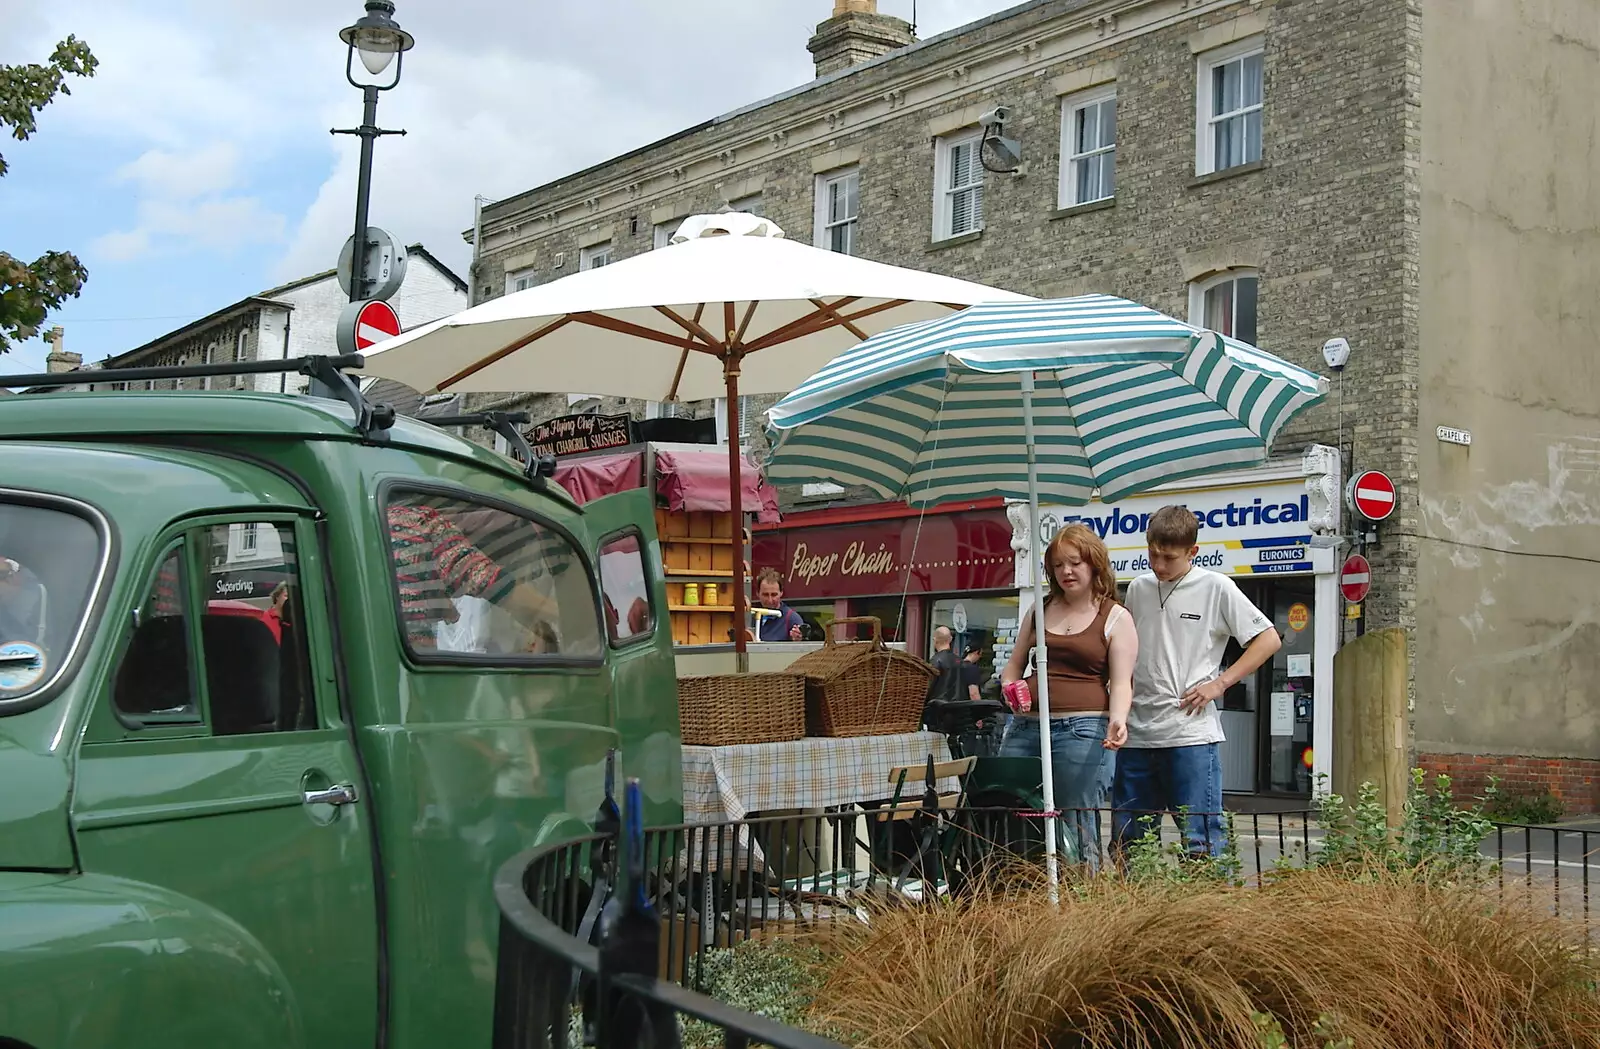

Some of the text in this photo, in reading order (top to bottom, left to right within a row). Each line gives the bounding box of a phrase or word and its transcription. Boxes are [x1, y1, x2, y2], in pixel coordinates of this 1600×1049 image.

[536, 416, 595, 441] The Flying Chef
[557, 437, 590, 453] CHARGRILL
[591, 429, 627, 447] SAUSAGES
[788, 541, 894, 586] Paper Chain
[1260, 549, 1304, 561] EURONICS
[1268, 564, 1294, 572] CENTRE
[216, 580, 253, 594] Superdrug
